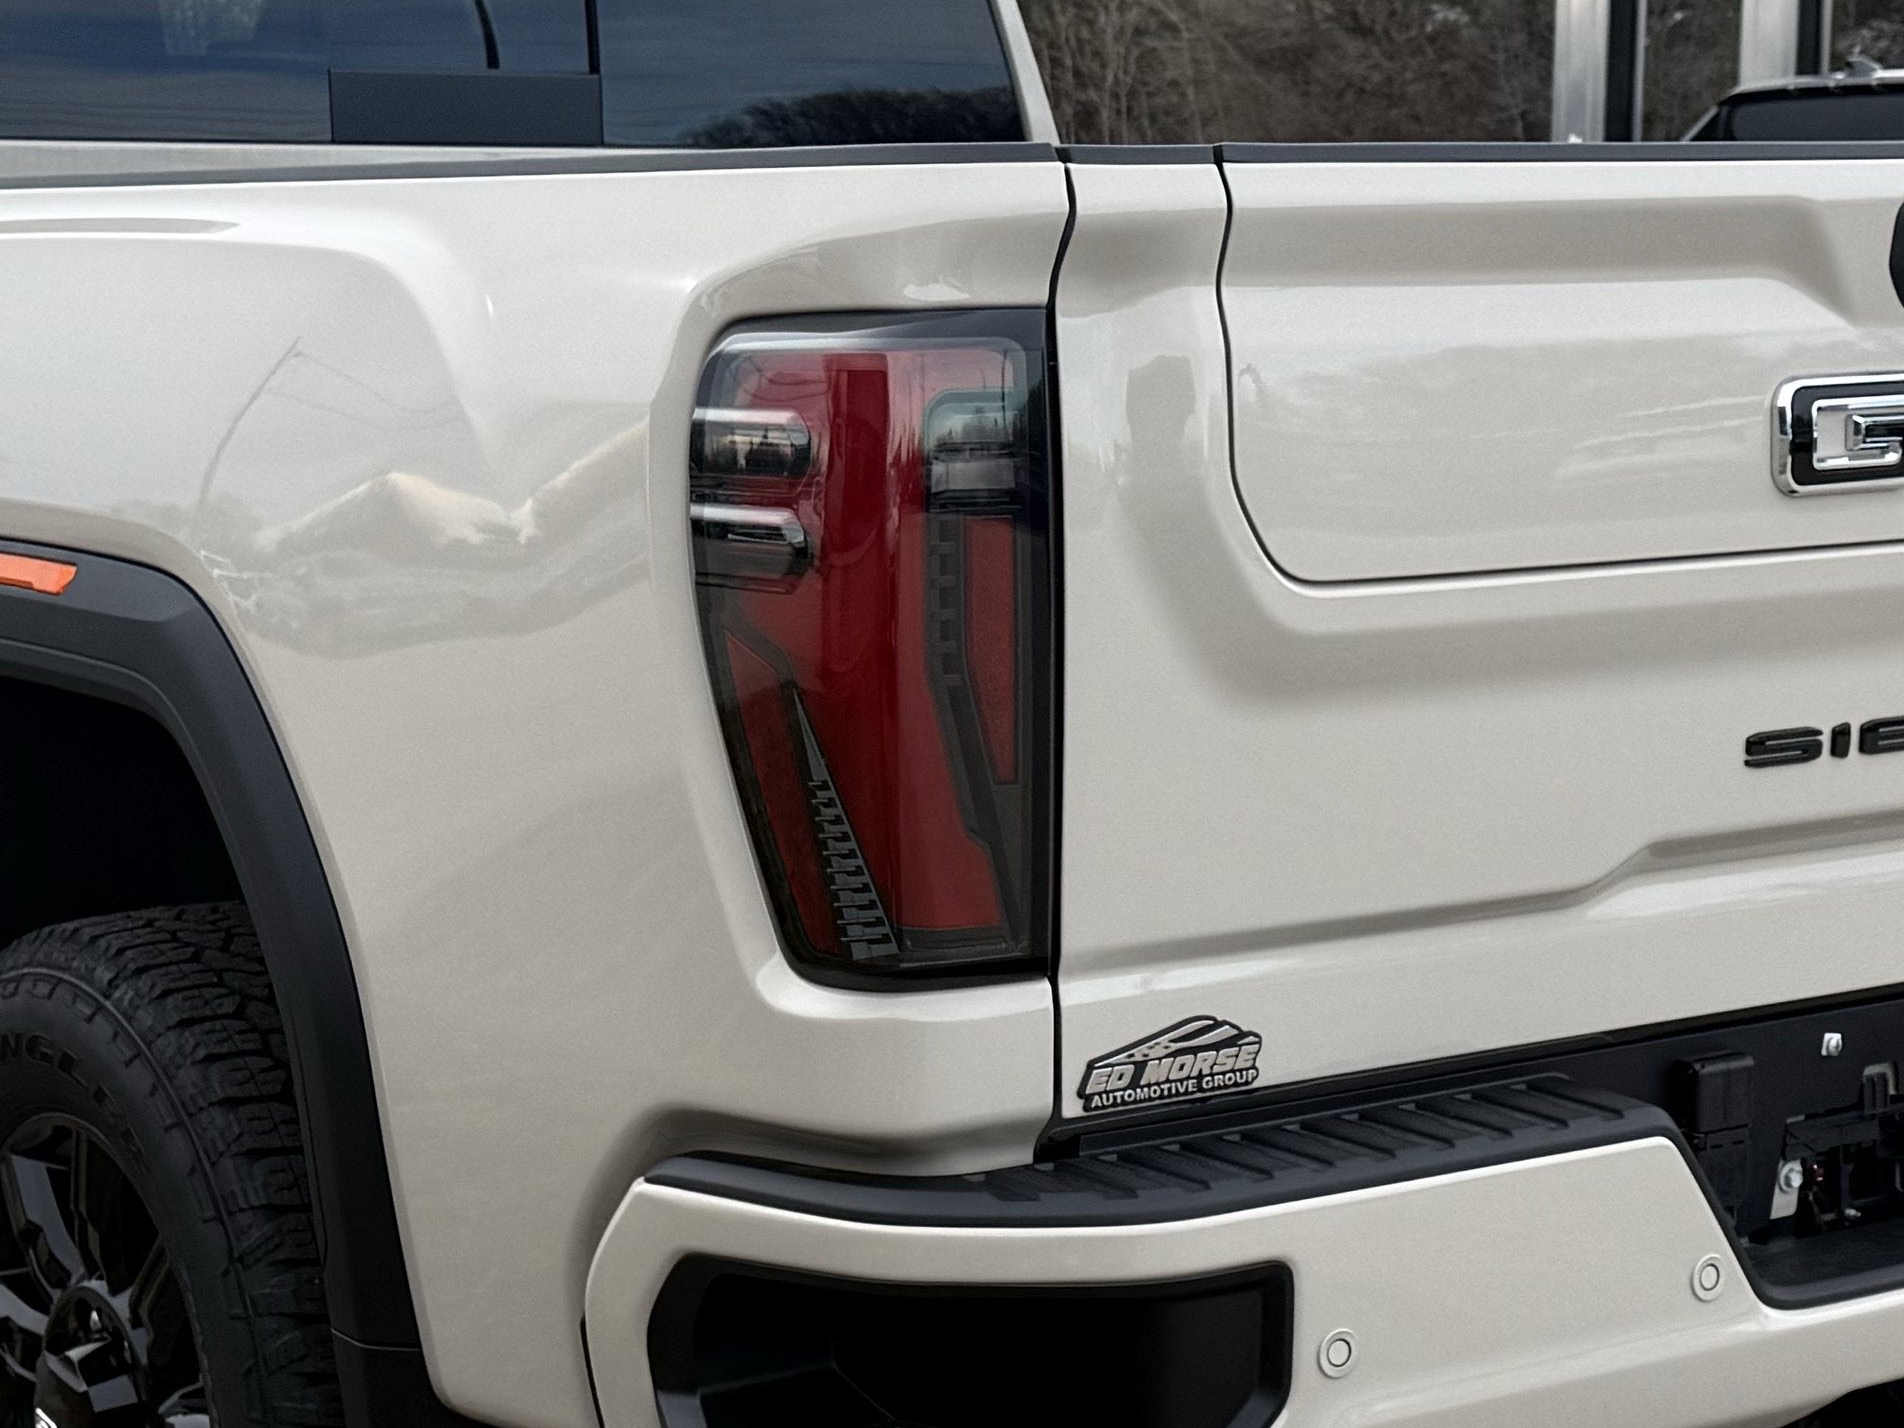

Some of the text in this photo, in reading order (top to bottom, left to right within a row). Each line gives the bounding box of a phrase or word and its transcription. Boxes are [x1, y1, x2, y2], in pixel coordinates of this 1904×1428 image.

[1086, 1045, 1259, 1094] ED MORSE
[1090, 1070, 1258, 1109] AUTOMOTIVE GROUP
